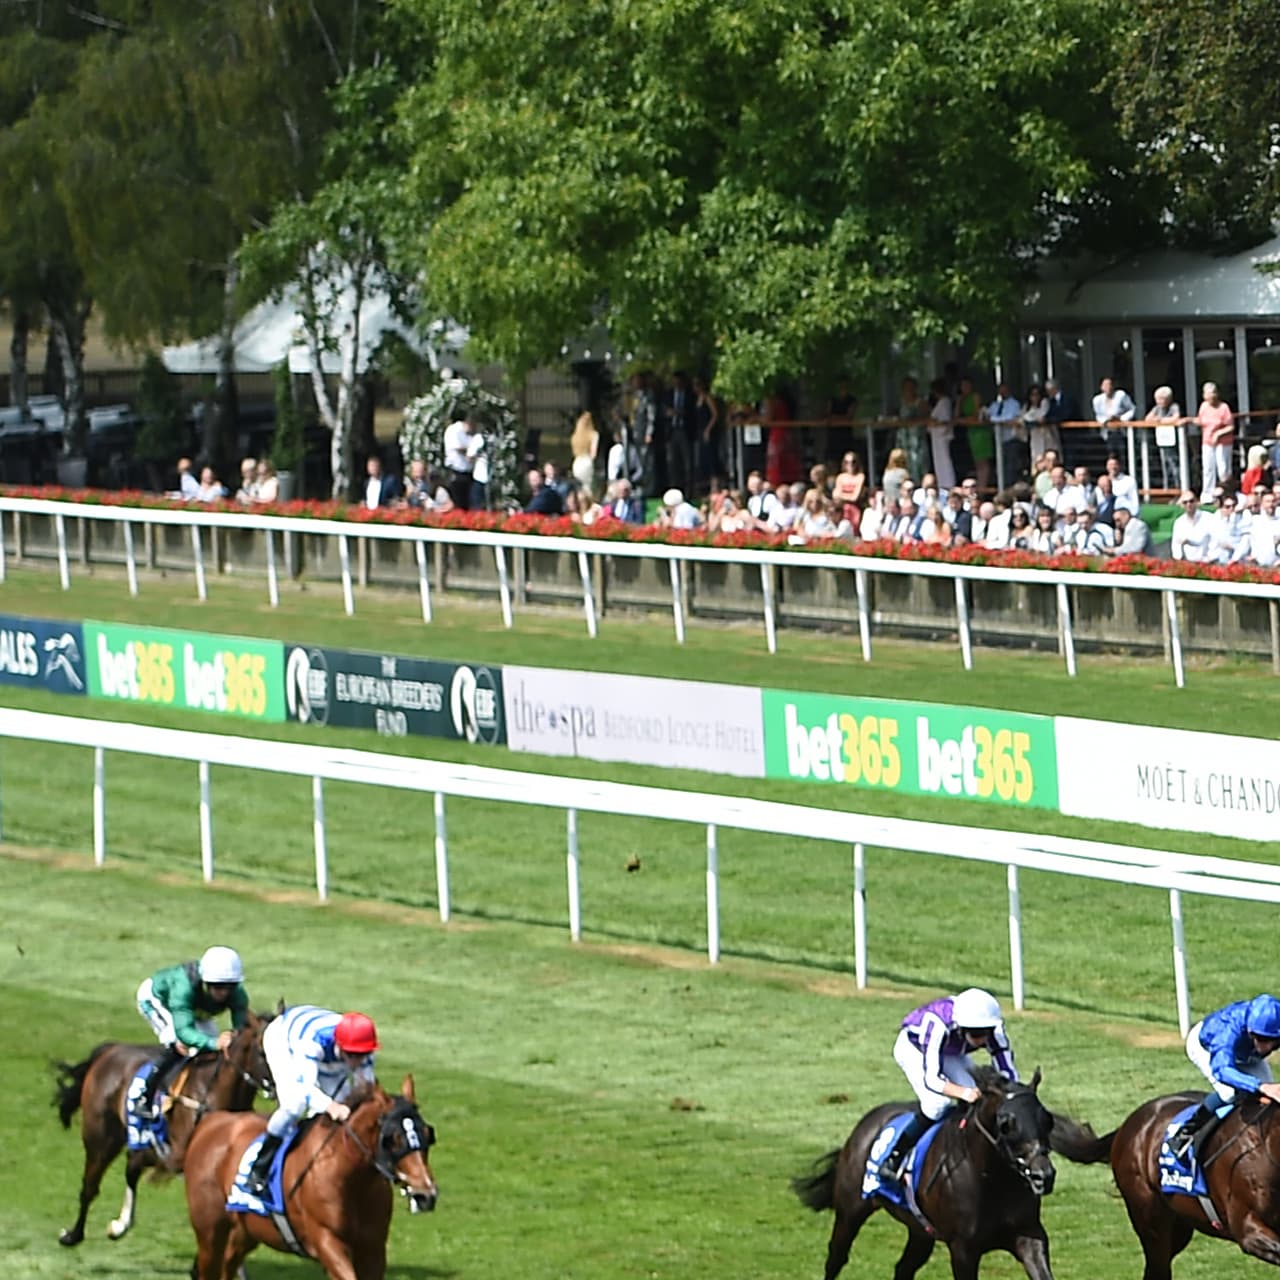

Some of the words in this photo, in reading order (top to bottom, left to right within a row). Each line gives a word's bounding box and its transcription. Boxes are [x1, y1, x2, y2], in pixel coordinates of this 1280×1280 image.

[97, 632, 175, 704] bet365
[184, 642, 266, 716] bet365
[785, 703, 901, 788] bet365
[917, 716, 1033, 803] bet365
[1136, 761, 1187, 804] MOËT
